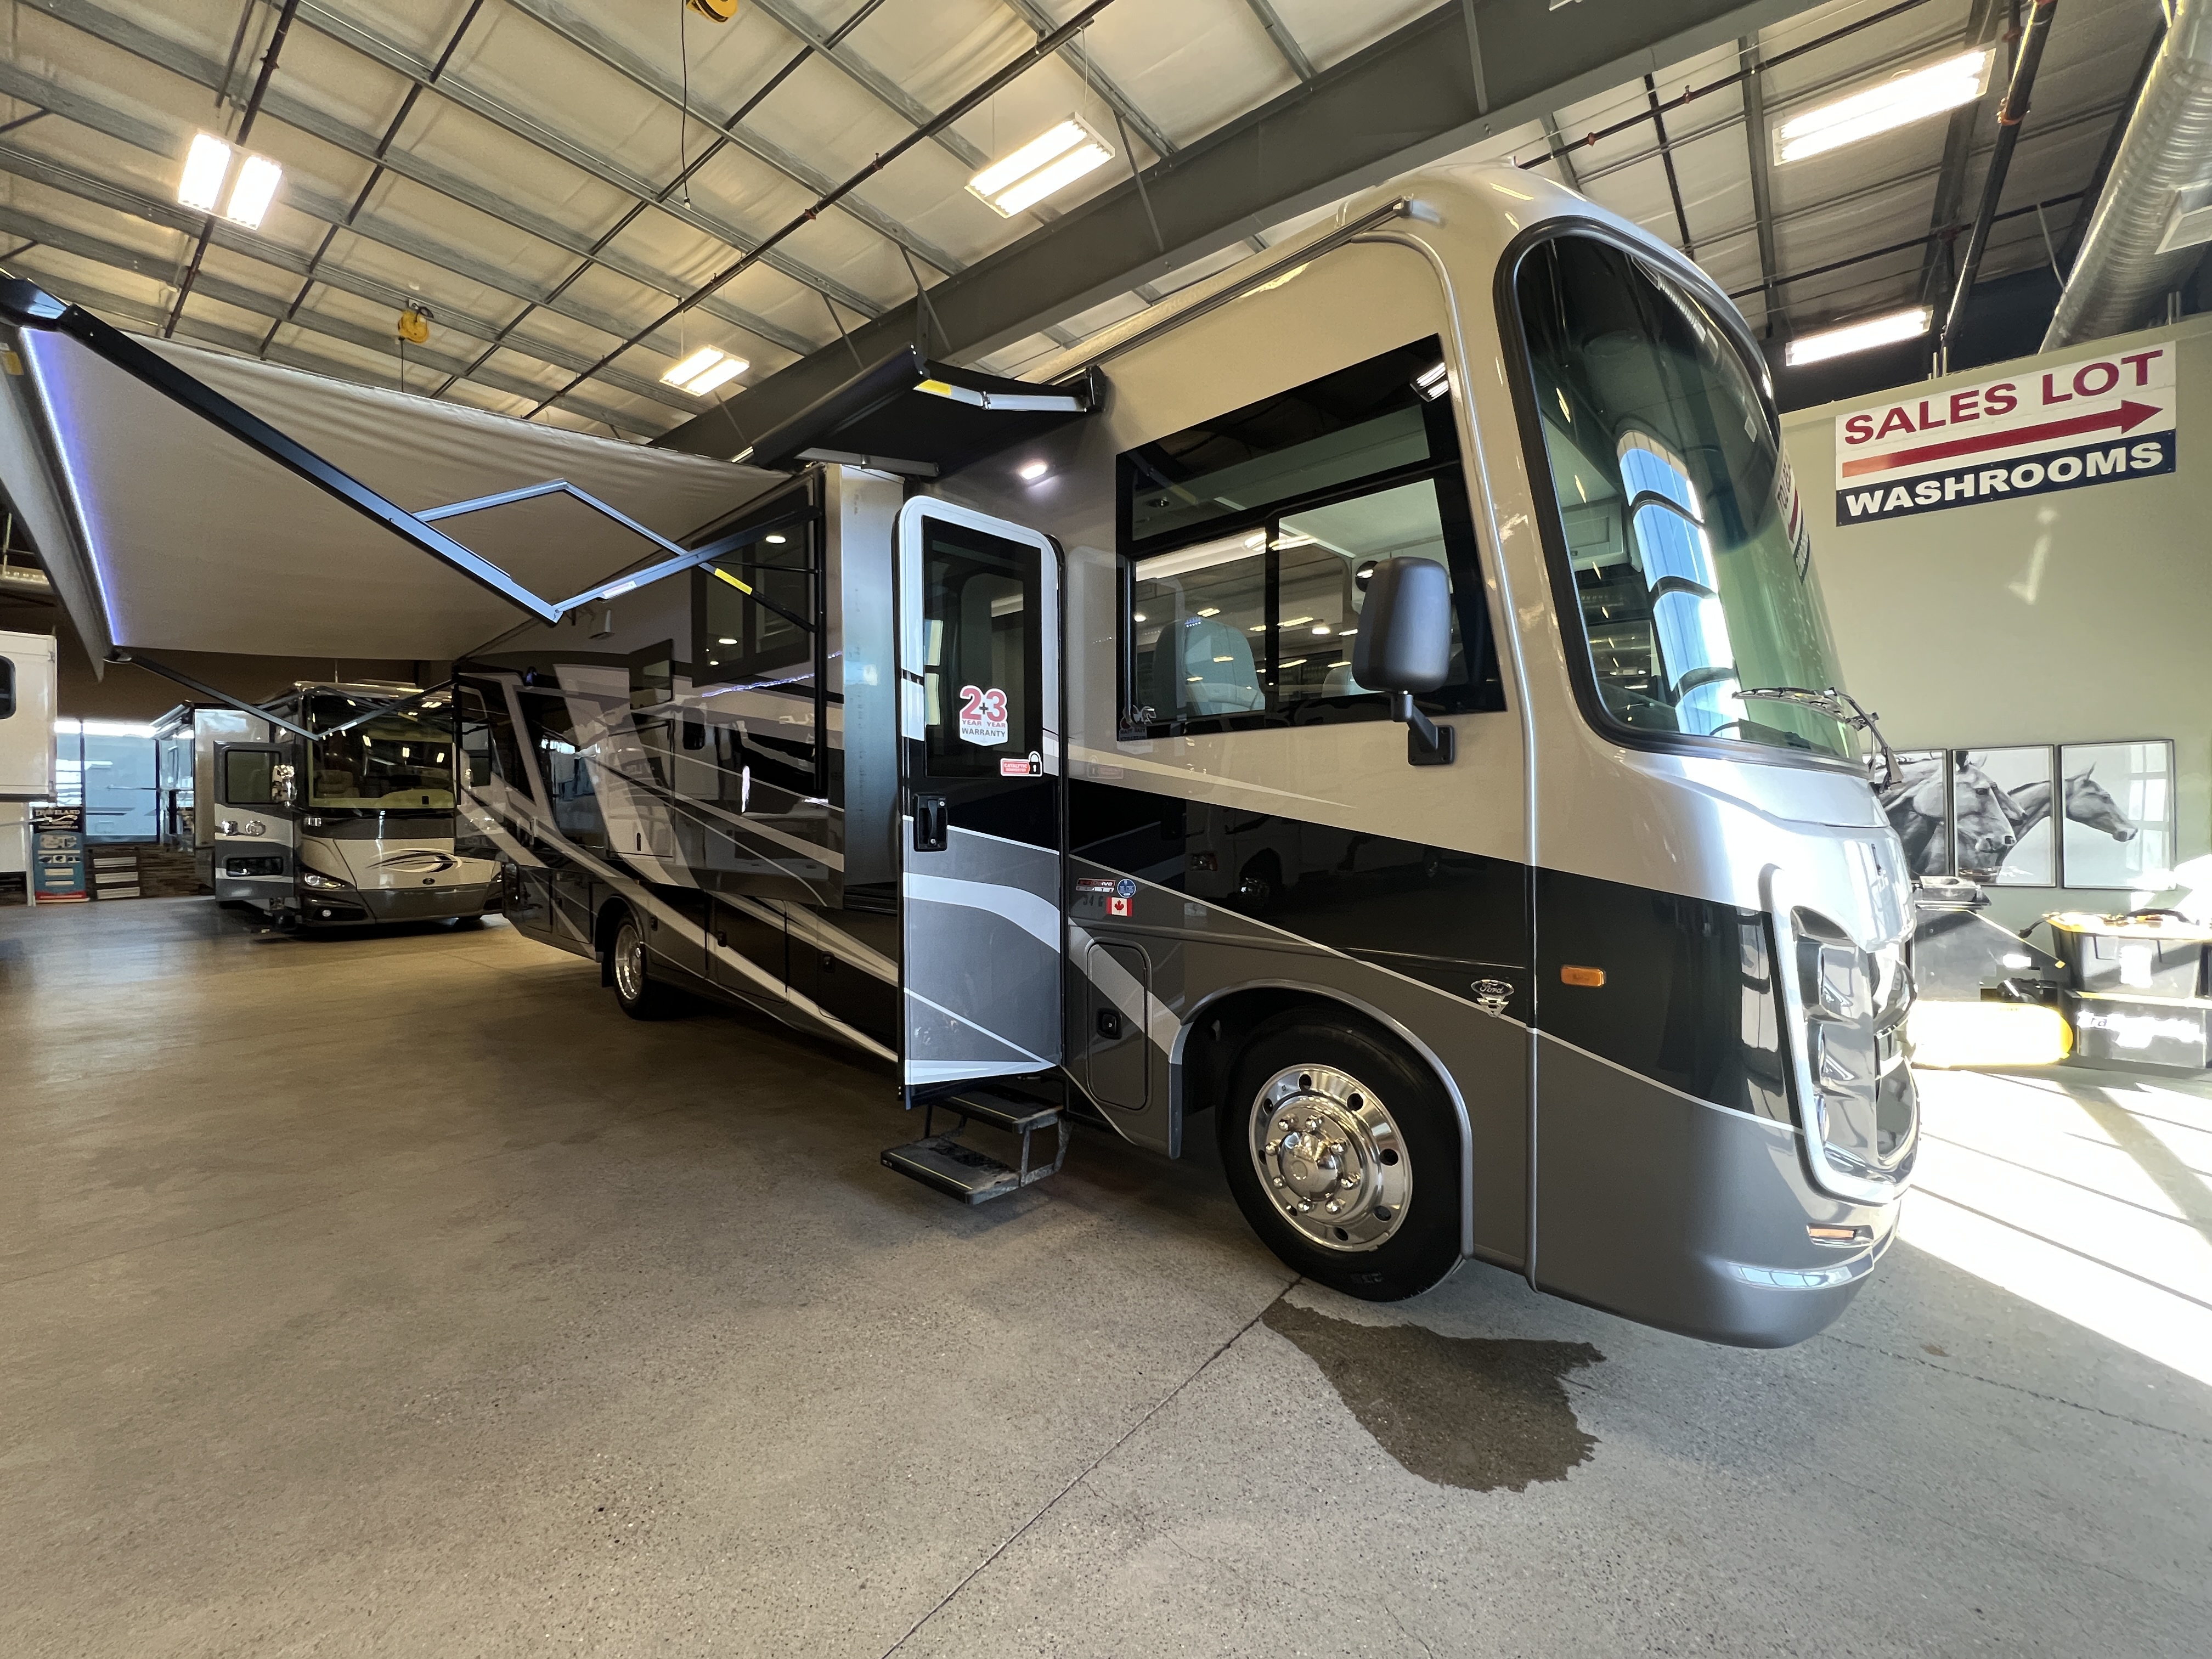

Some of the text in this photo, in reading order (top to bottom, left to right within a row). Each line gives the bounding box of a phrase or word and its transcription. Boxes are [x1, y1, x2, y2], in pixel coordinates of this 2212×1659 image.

[1844, 349, 2164, 445] SALES LOT
[1846, 441, 2164, 517] WASHROOMS
[962, 727, 1006, 737] WARRANTY
[1480, 983, 1504, 994] Ford
